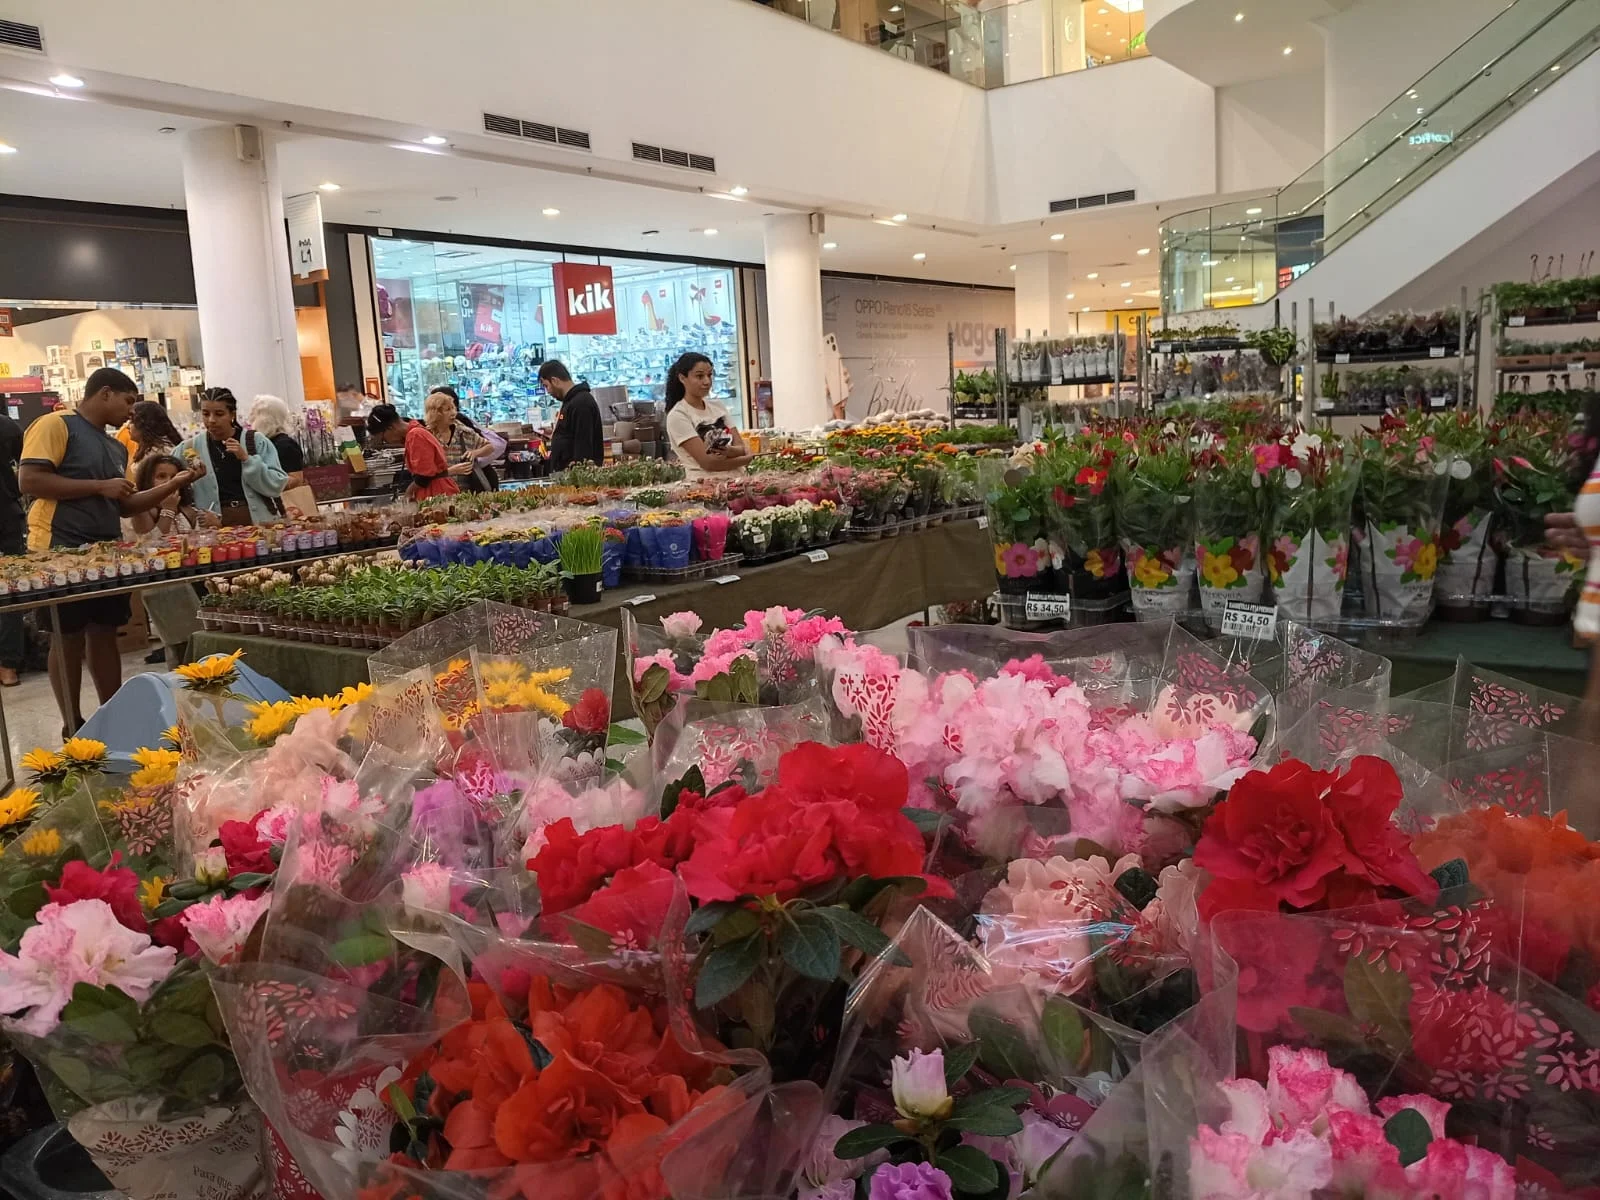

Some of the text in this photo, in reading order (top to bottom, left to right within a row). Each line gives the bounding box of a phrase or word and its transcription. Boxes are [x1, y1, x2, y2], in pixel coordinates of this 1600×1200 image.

[567, 282, 613, 316] kik
[855, 298, 882, 315] OPPO
[947, 321, 1016, 357] Maga
[1040, 603, 1064, 614] 34,50
[1241, 614, 1269, 628] 34,50
